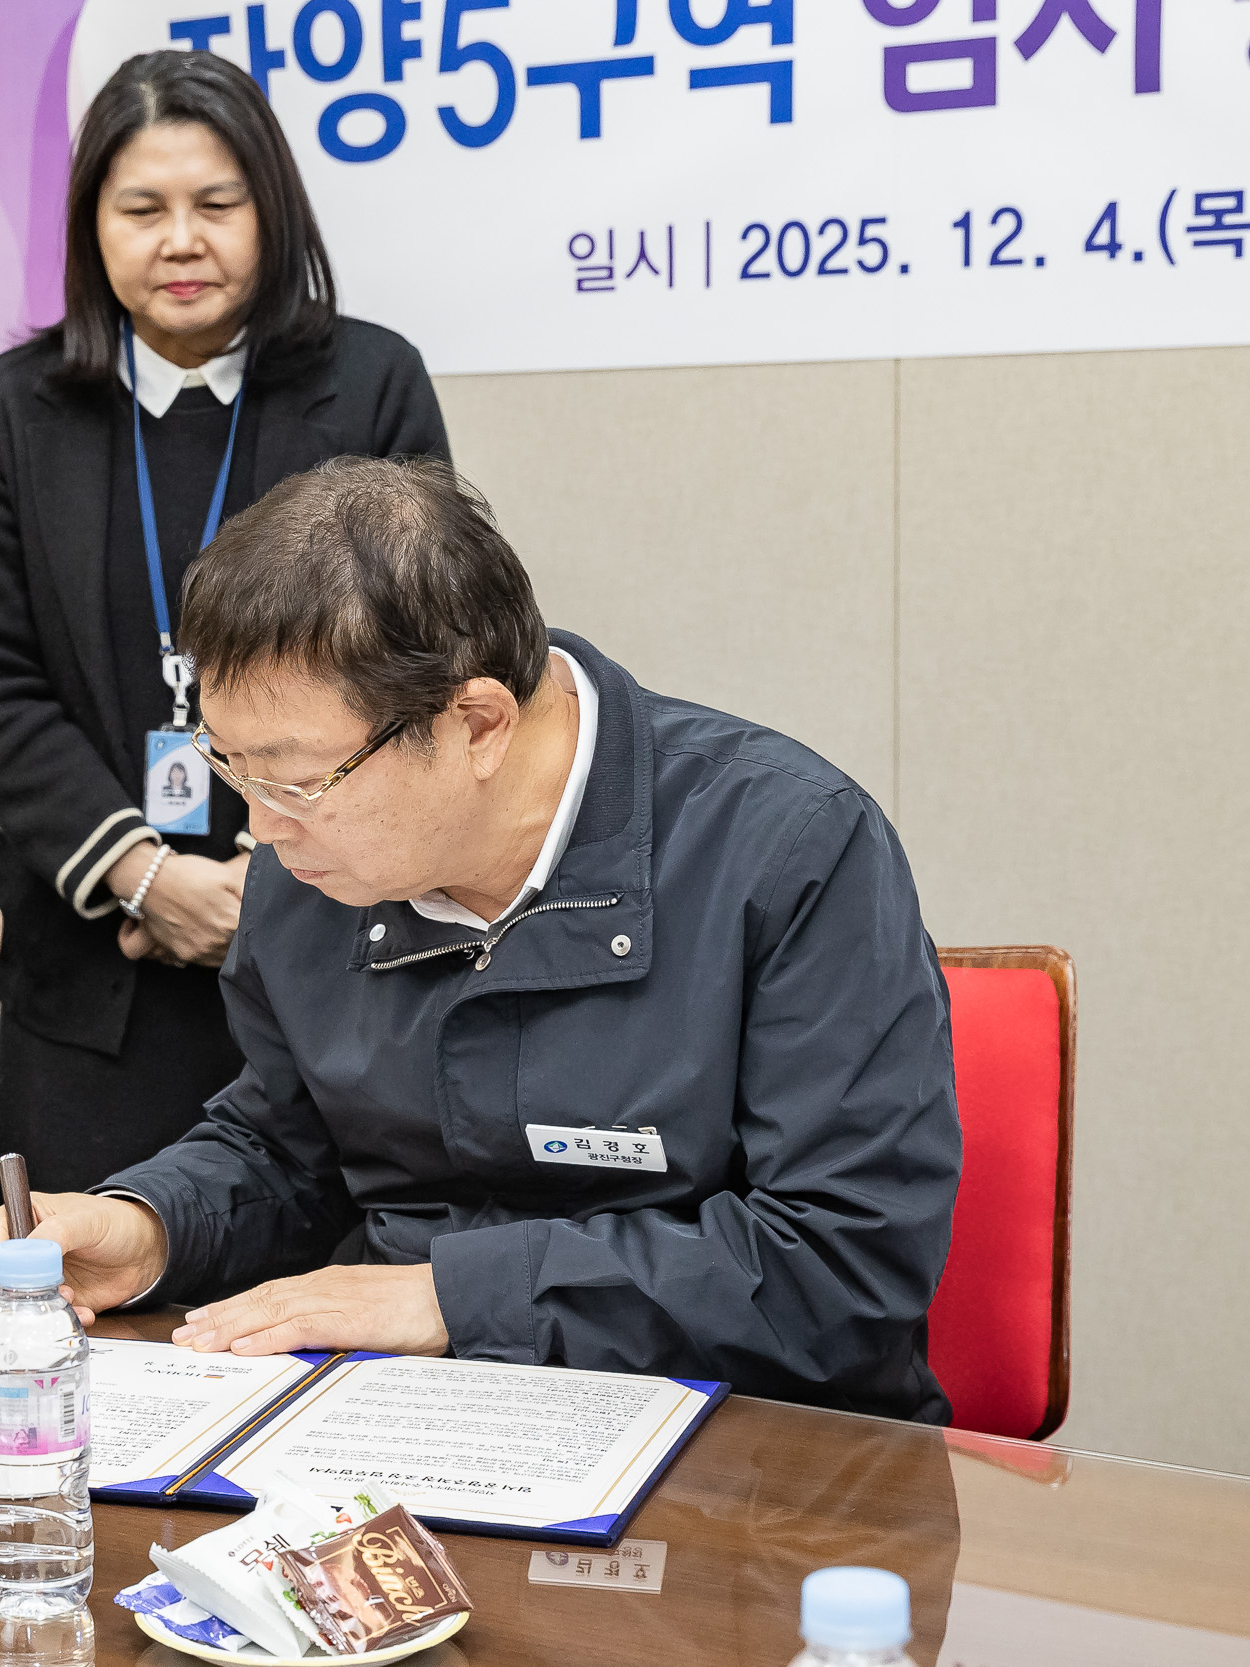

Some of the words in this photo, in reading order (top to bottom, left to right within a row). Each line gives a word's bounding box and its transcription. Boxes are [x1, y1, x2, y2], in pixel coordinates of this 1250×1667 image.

[864, 0, 1161, 113] 임시
[568, 223, 674, 292] 일시
[739, 216, 909, 280] 2025.
[952, 206, 1045, 268] 12.
[587, 1152, 643, 1165] 광진구청장
[351, 1531, 437, 1628] Binch
